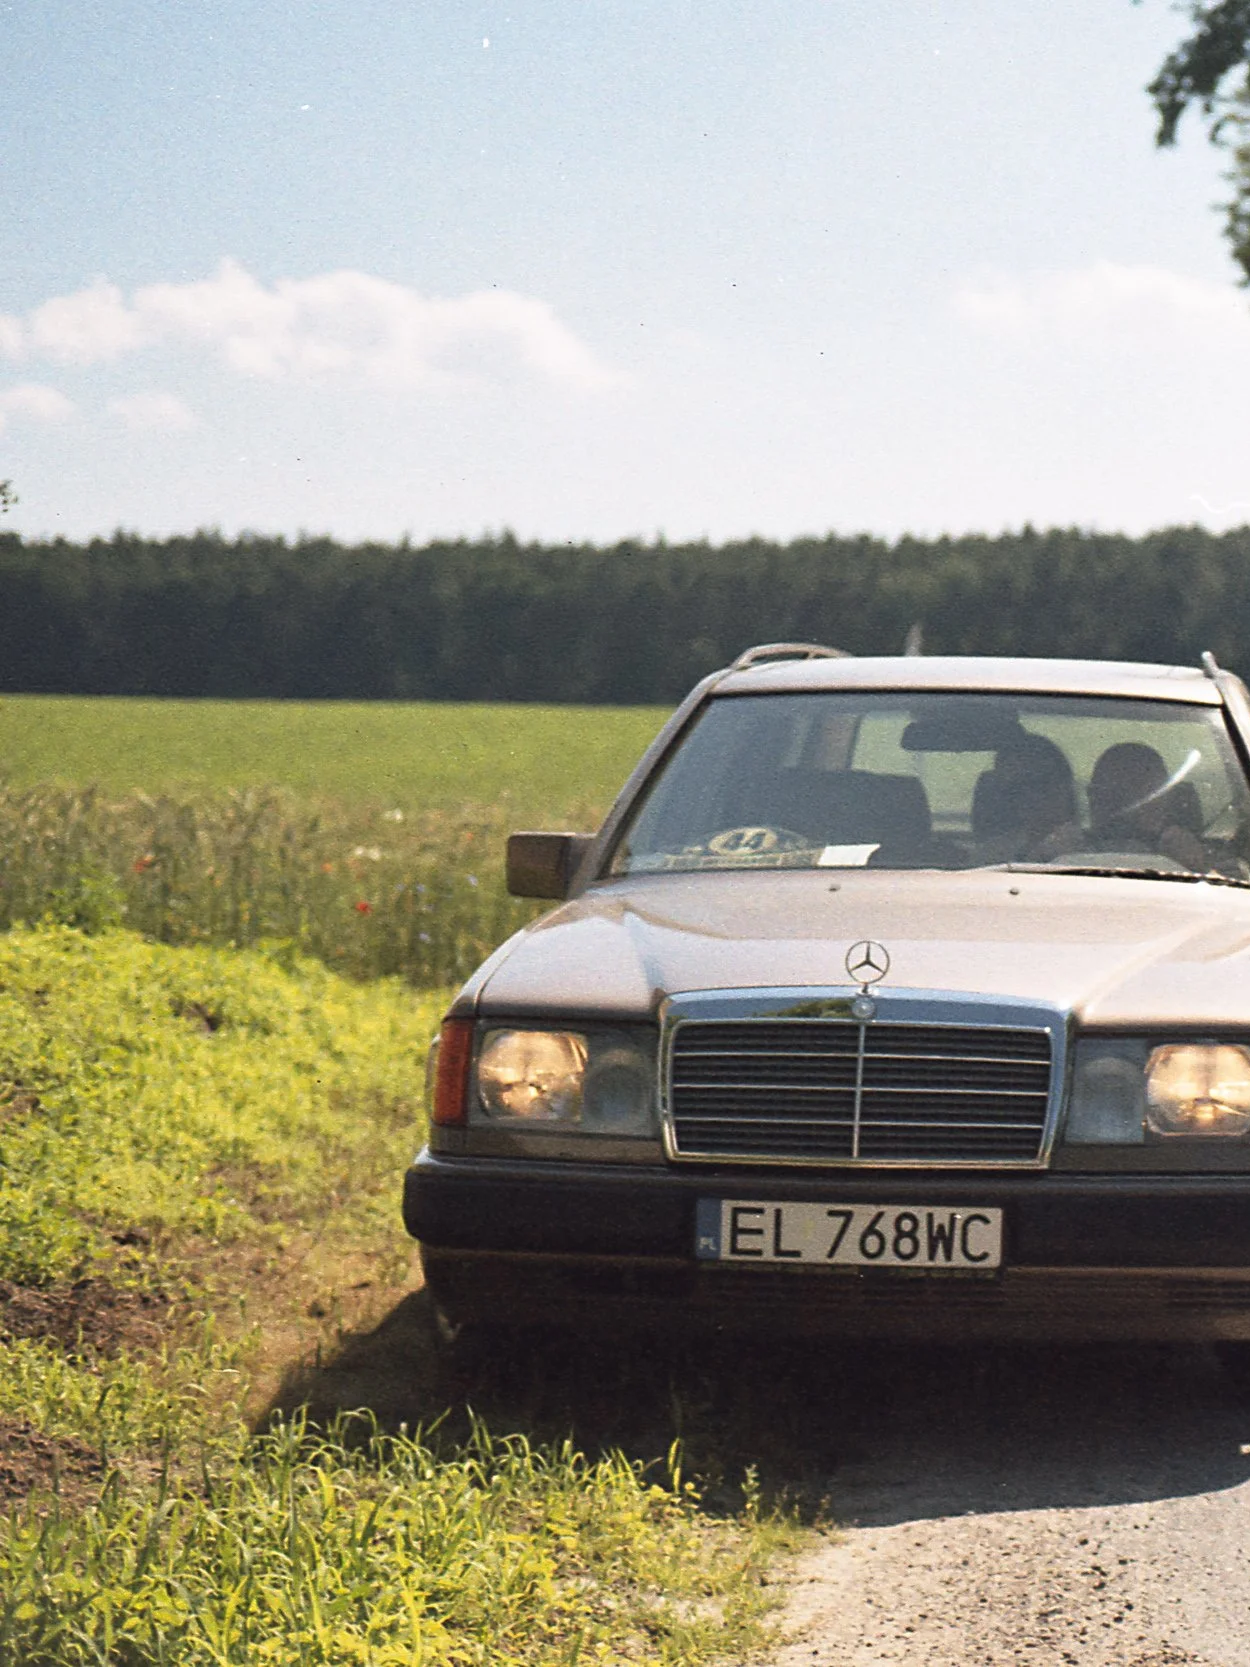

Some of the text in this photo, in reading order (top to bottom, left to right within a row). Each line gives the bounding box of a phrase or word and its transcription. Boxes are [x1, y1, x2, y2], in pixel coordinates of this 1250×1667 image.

[700, 1236, 717, 1251] PL
[729, 1206, 991, 1263] EL 768WC
